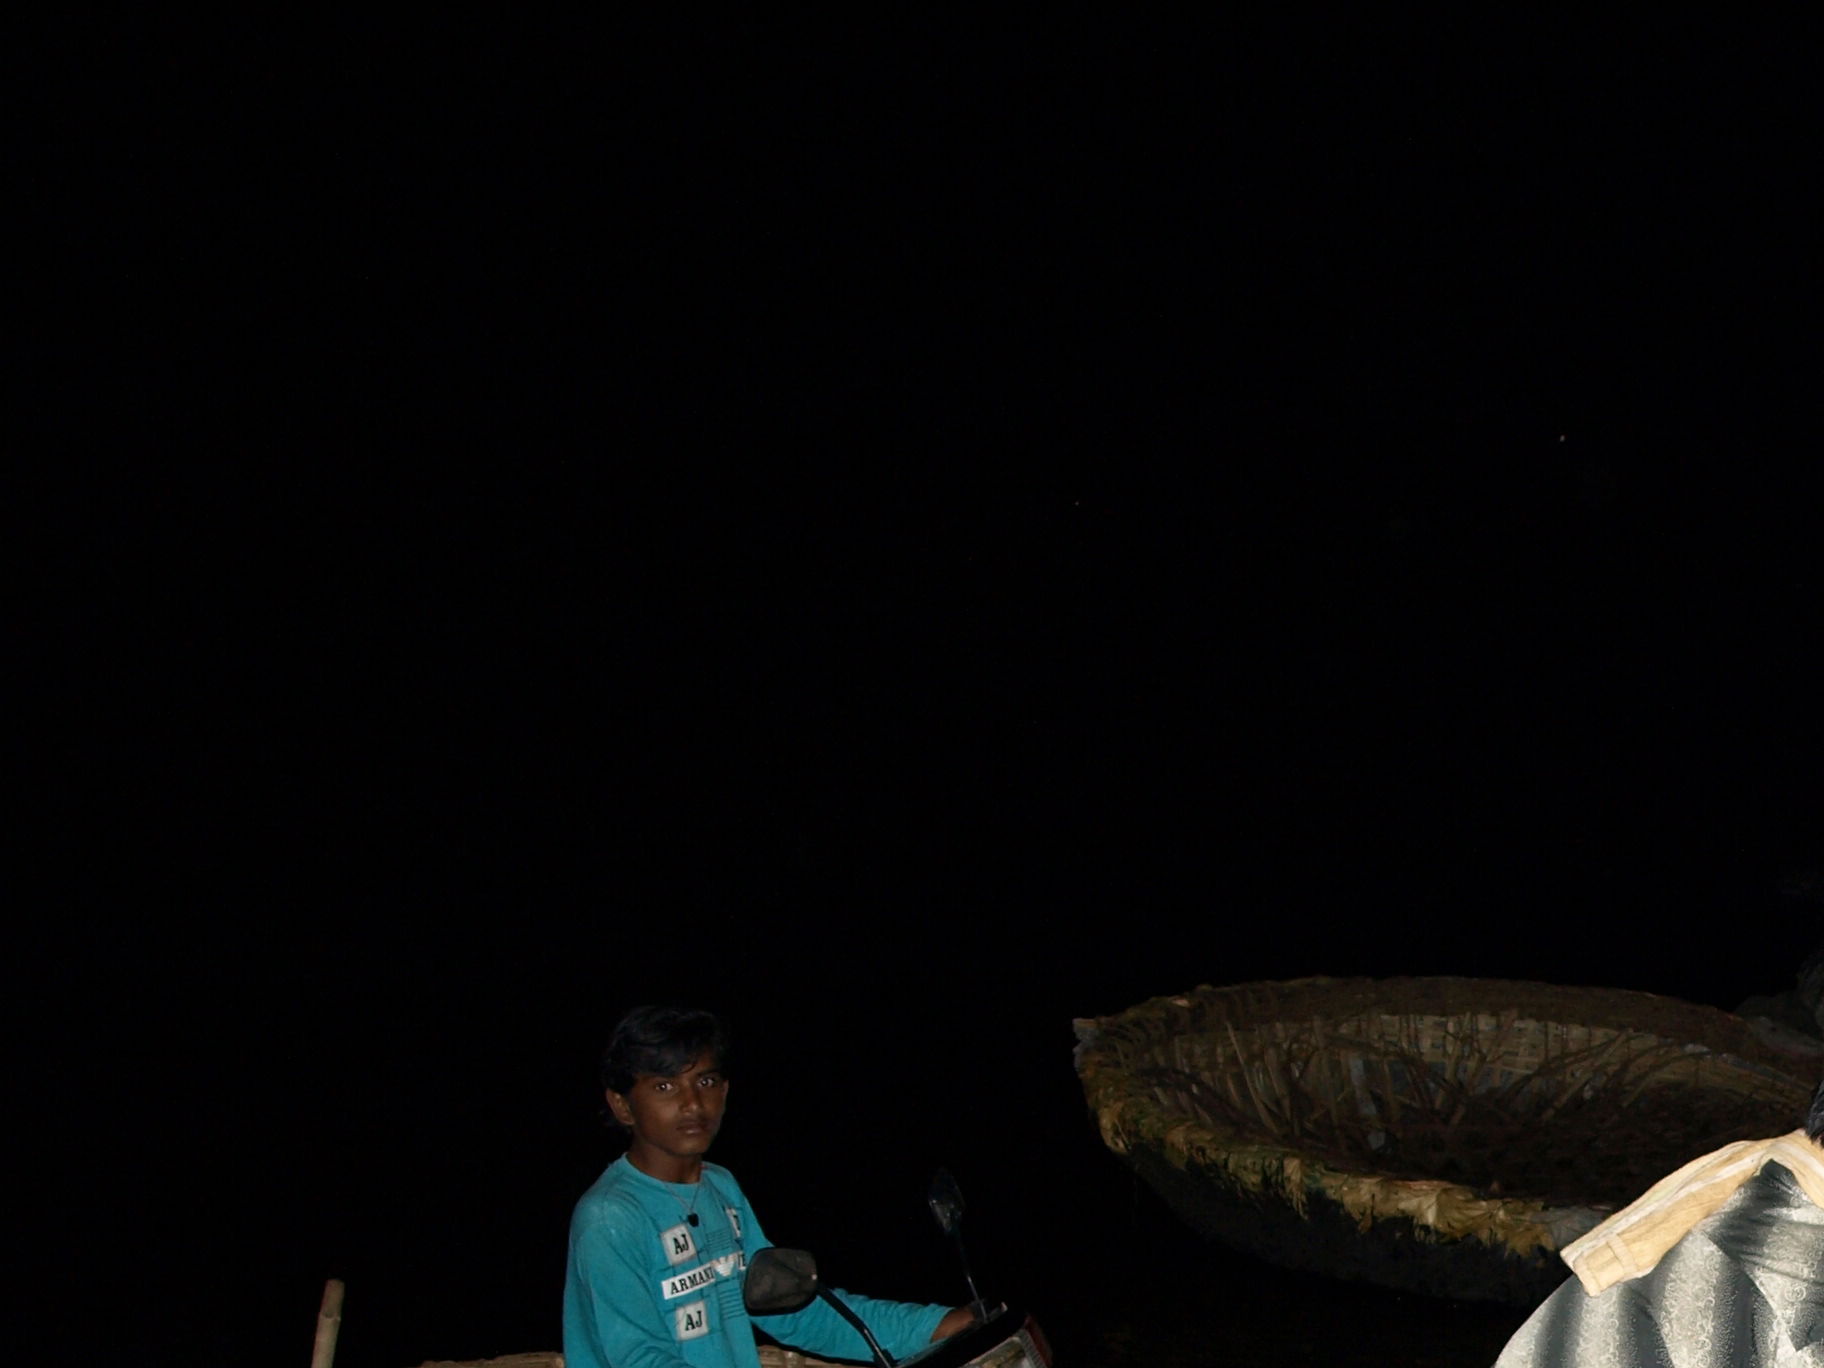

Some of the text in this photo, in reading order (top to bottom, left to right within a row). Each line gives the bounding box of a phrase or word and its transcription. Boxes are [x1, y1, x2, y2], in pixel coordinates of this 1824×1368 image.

[673, 1233, 690, 1255] AJ
[670, 1266, 714, 1295] ARMANI
[685, 1310, 703, 1331] AJ
